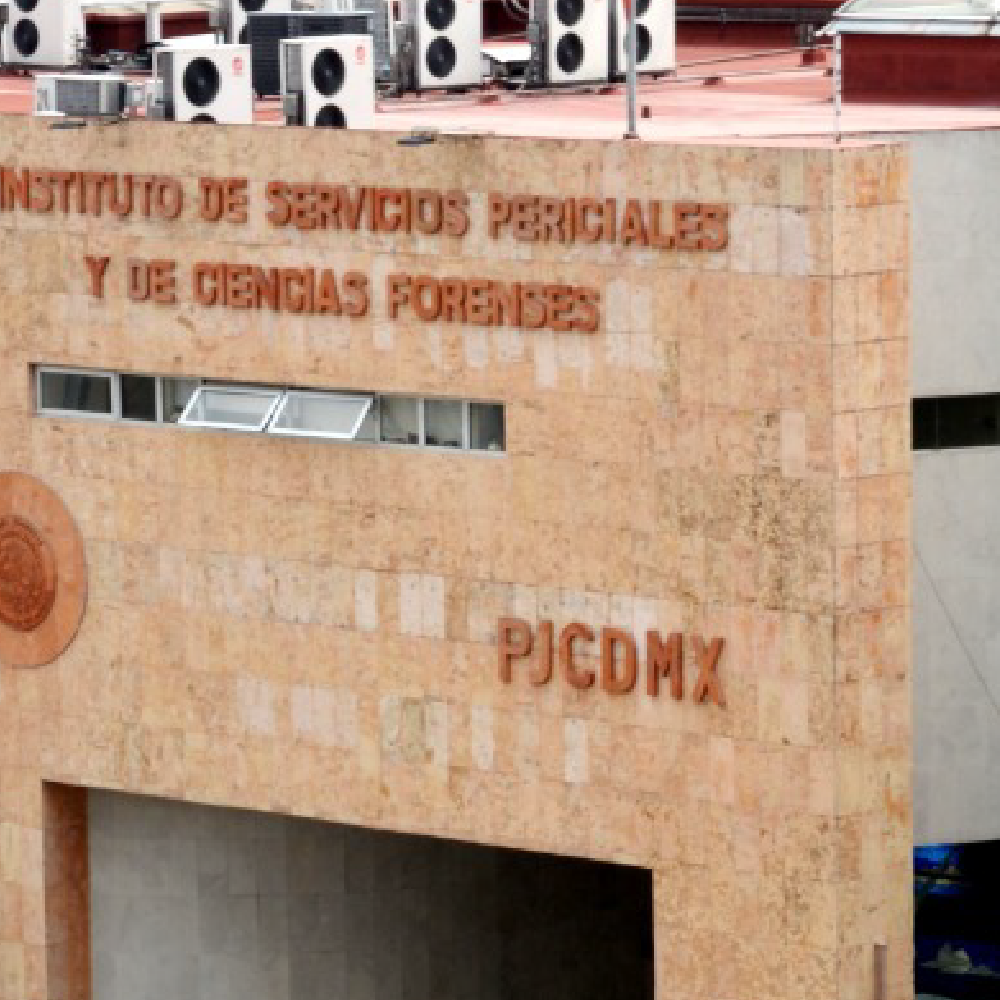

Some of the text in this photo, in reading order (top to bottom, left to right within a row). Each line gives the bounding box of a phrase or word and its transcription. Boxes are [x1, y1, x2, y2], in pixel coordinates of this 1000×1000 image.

[0, 168, 729, 252] NSTITUTO DE SERVICIOS PERICIALES
[83, 255, 600, 334] Y DE CIENCIAS FORENSES
[498, 617, 728, 710] PJCDMX
